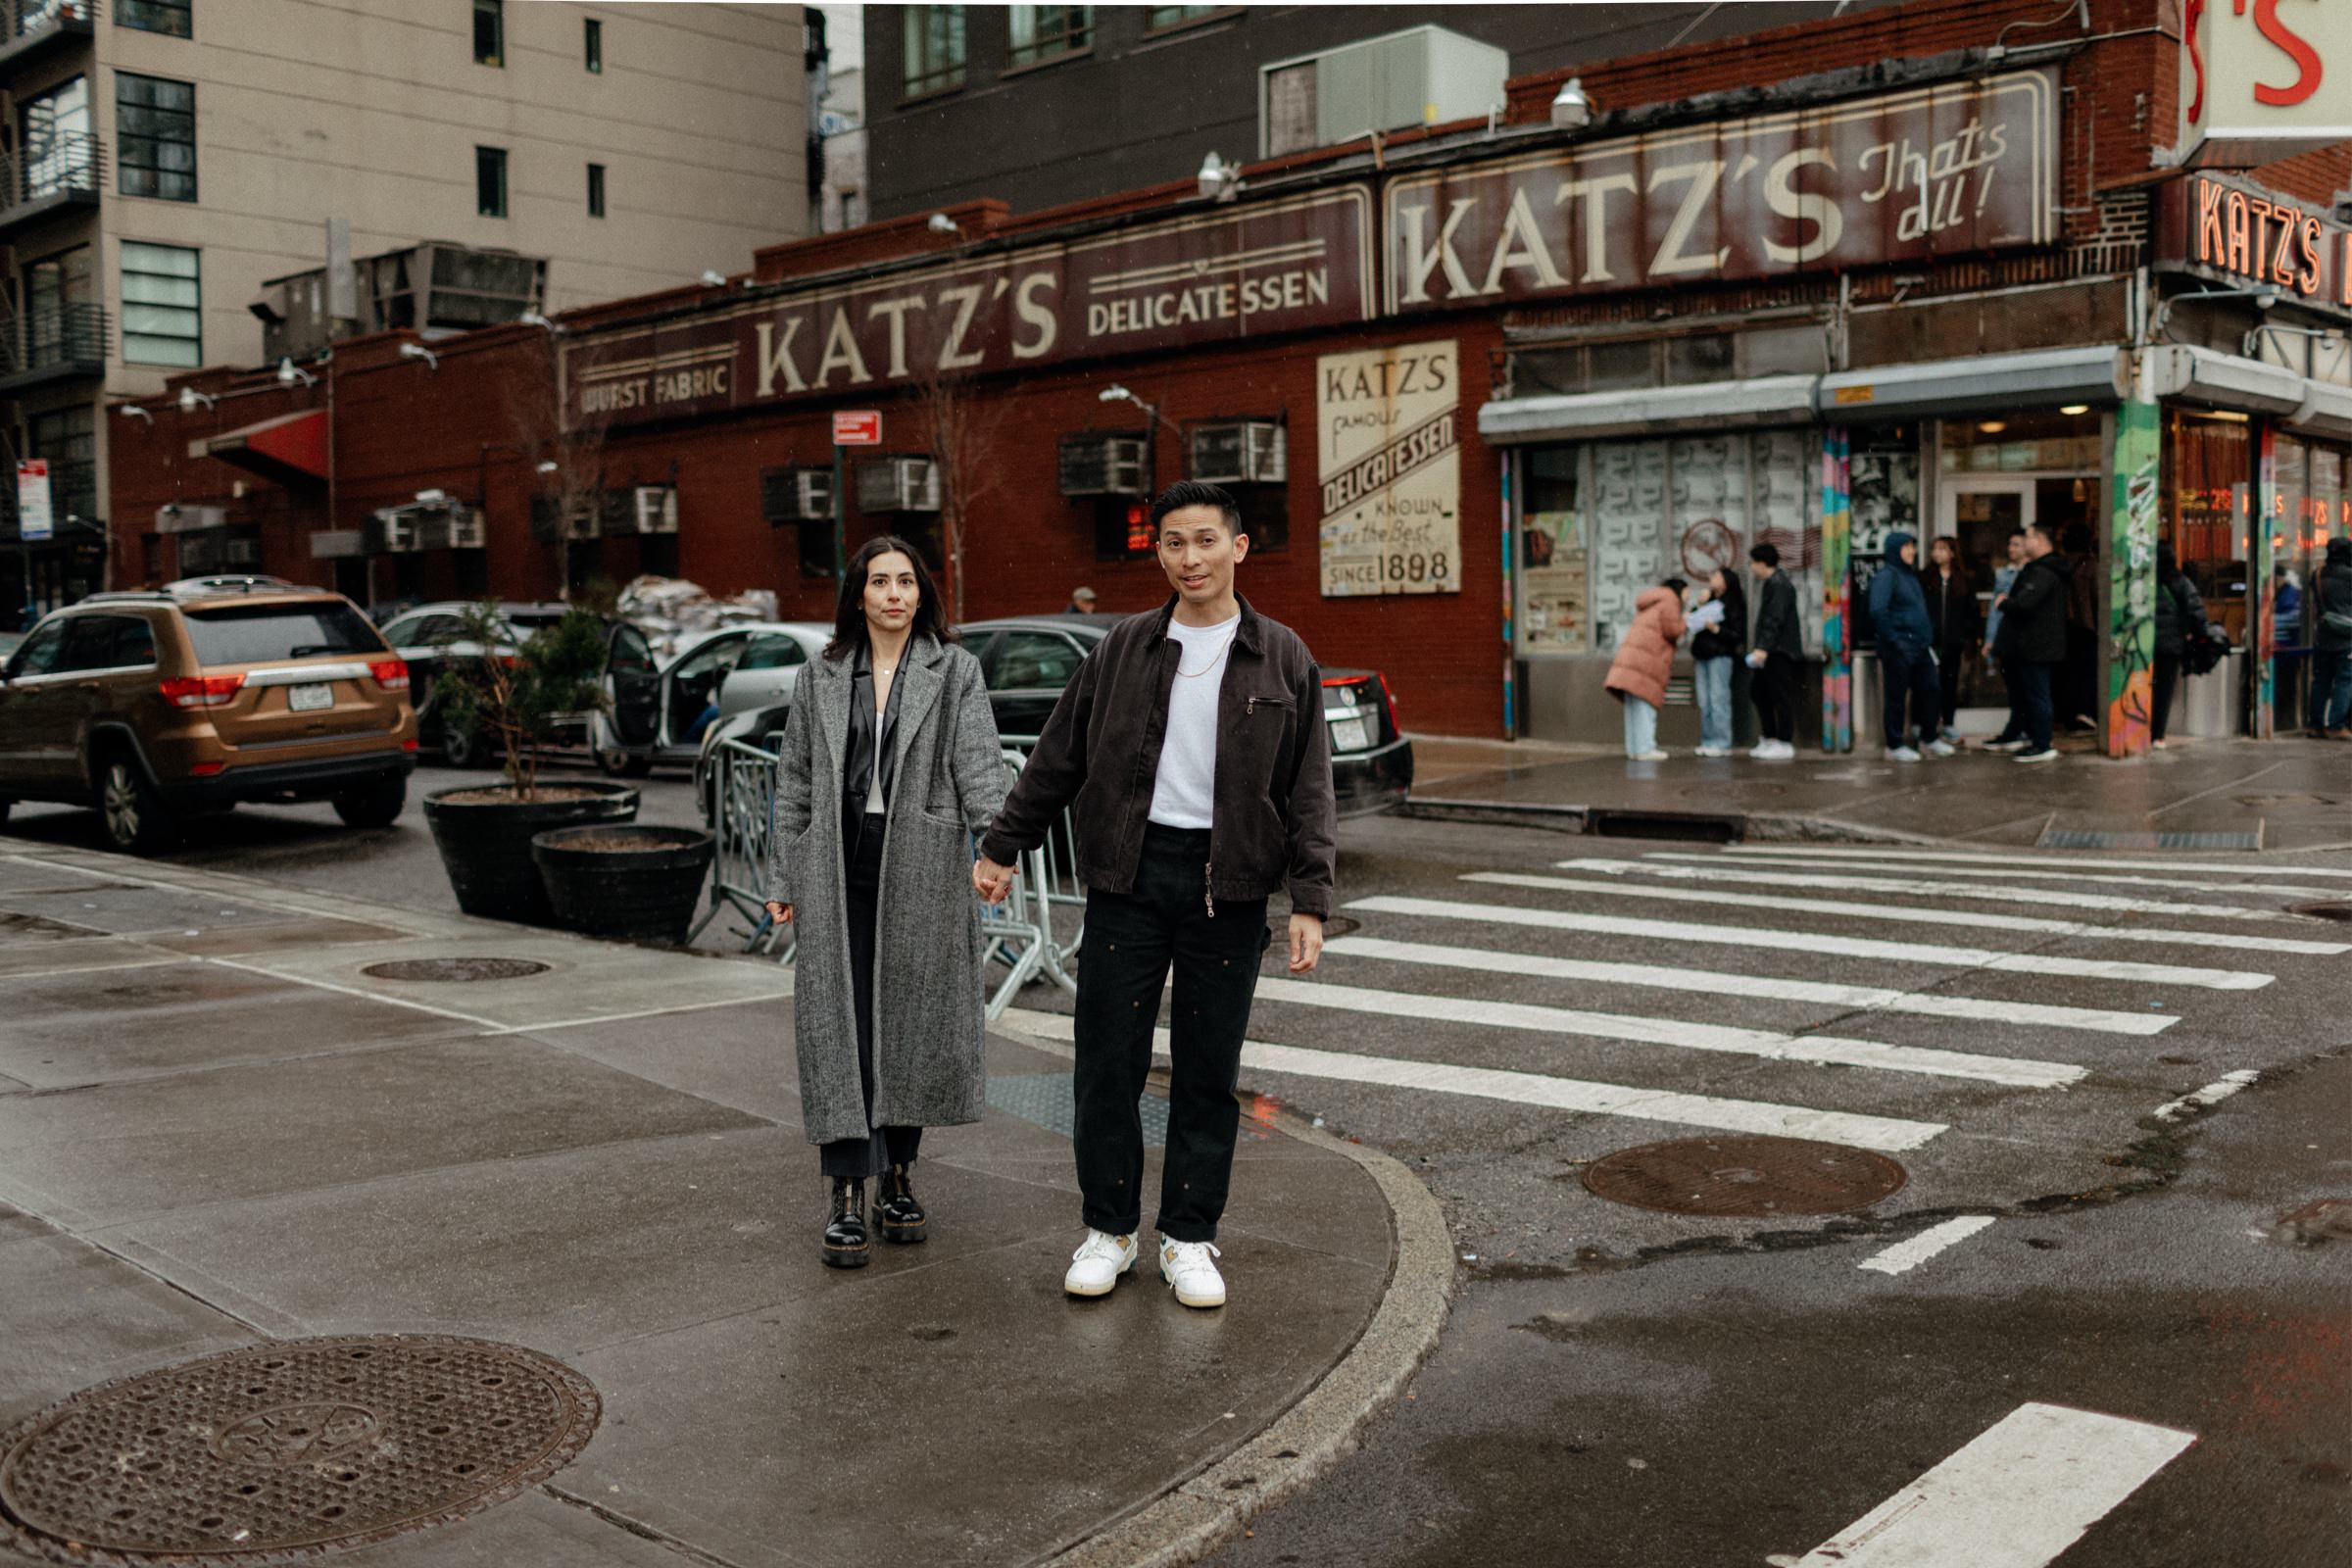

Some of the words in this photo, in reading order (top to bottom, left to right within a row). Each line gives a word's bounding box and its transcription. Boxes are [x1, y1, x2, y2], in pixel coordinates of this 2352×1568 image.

[1858, 117, 2007, 203] That's
[1399, 146, 1843, 304] KATZ'S
[2199, 178, 2322, 294] KATZ'S
[755, 272, 1058, 398] KATZ'S
[1088, 269, 1330, 337] DELICATESSEN
[654, 365, 727, 405] FABRIC
[1325, 354, 1446, 404] KATZ'S
[1323, 414, 1454, 512] DELICATESSEN
[1330, 565, 1375, 585] SINCE
